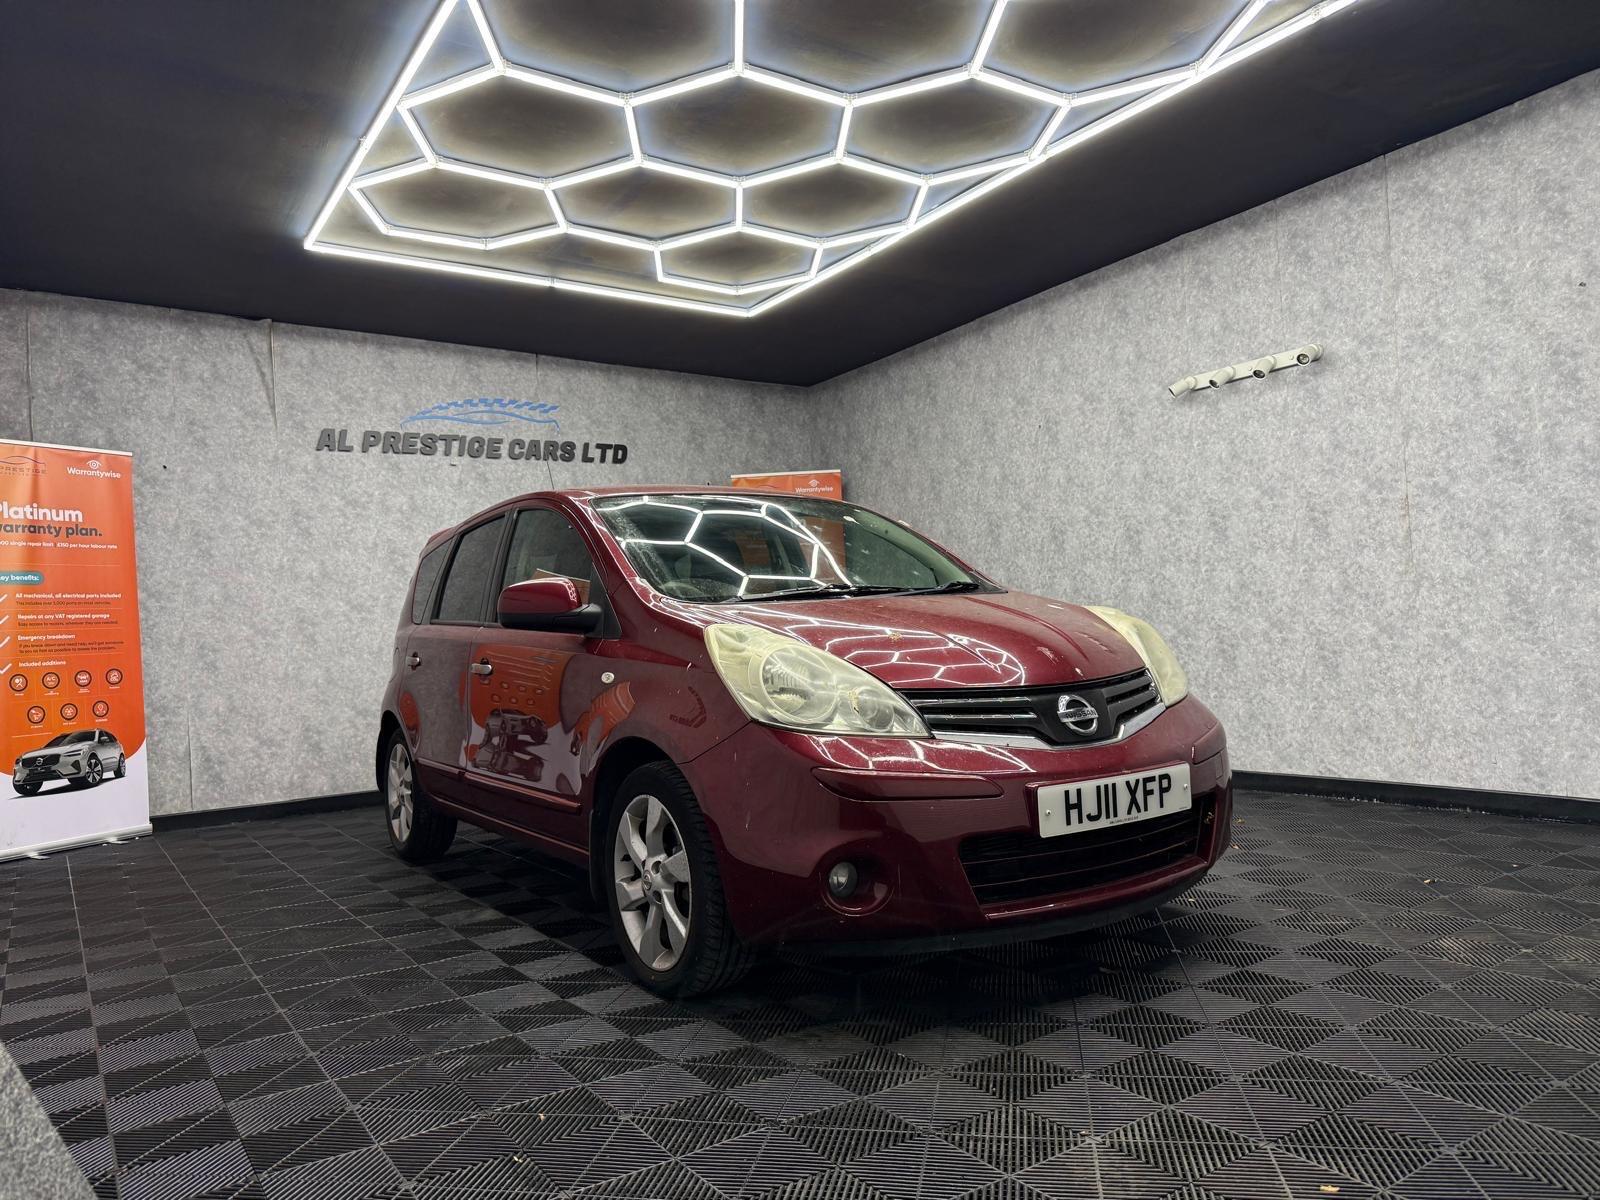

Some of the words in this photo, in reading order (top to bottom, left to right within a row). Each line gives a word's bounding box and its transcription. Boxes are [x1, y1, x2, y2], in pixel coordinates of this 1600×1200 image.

[315, 428, 354, 453] AL
[361, 429, 503, 459] PRESTIGE
[508, 438, 576, 463] CARS
[581, 442, 628, 465] LTD
[66, 467, 121, 479] Warrantywise
[0, 500, 83, 522] latinum
[0, 523, 62, 538] arranty
[65, 524, 103, 538] plan.
[1065, 709, 1097, 719] NISSAN
[1125, 772, 1172, 816] XFP
